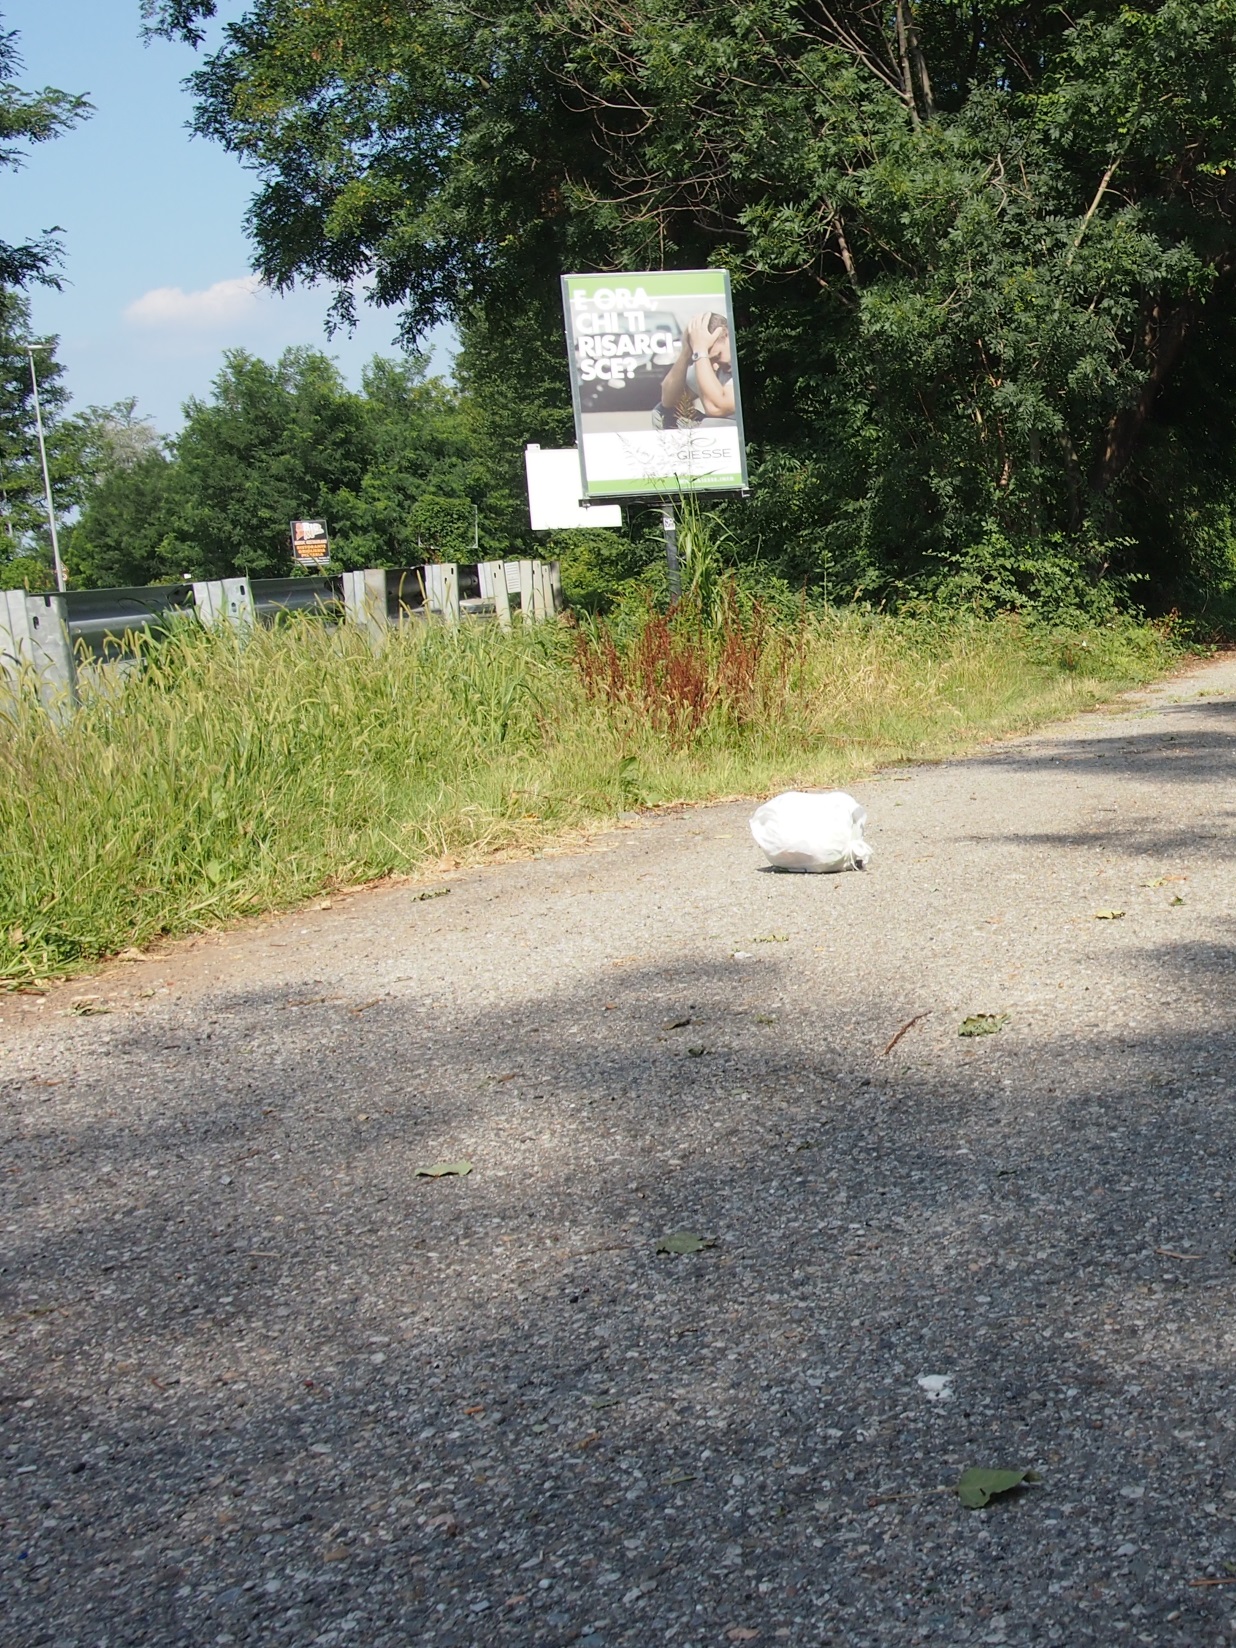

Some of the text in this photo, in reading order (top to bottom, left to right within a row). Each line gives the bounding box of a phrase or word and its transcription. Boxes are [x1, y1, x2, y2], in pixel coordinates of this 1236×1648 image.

[573, 287, 659, 311] E ORA,
[575, 311, 646, 334] CHI TI
[577, 332, 682, 357] RISARCI-
[580, 356, 638, 381] SCE?
[677, 448, 732, 460] GIESSE
